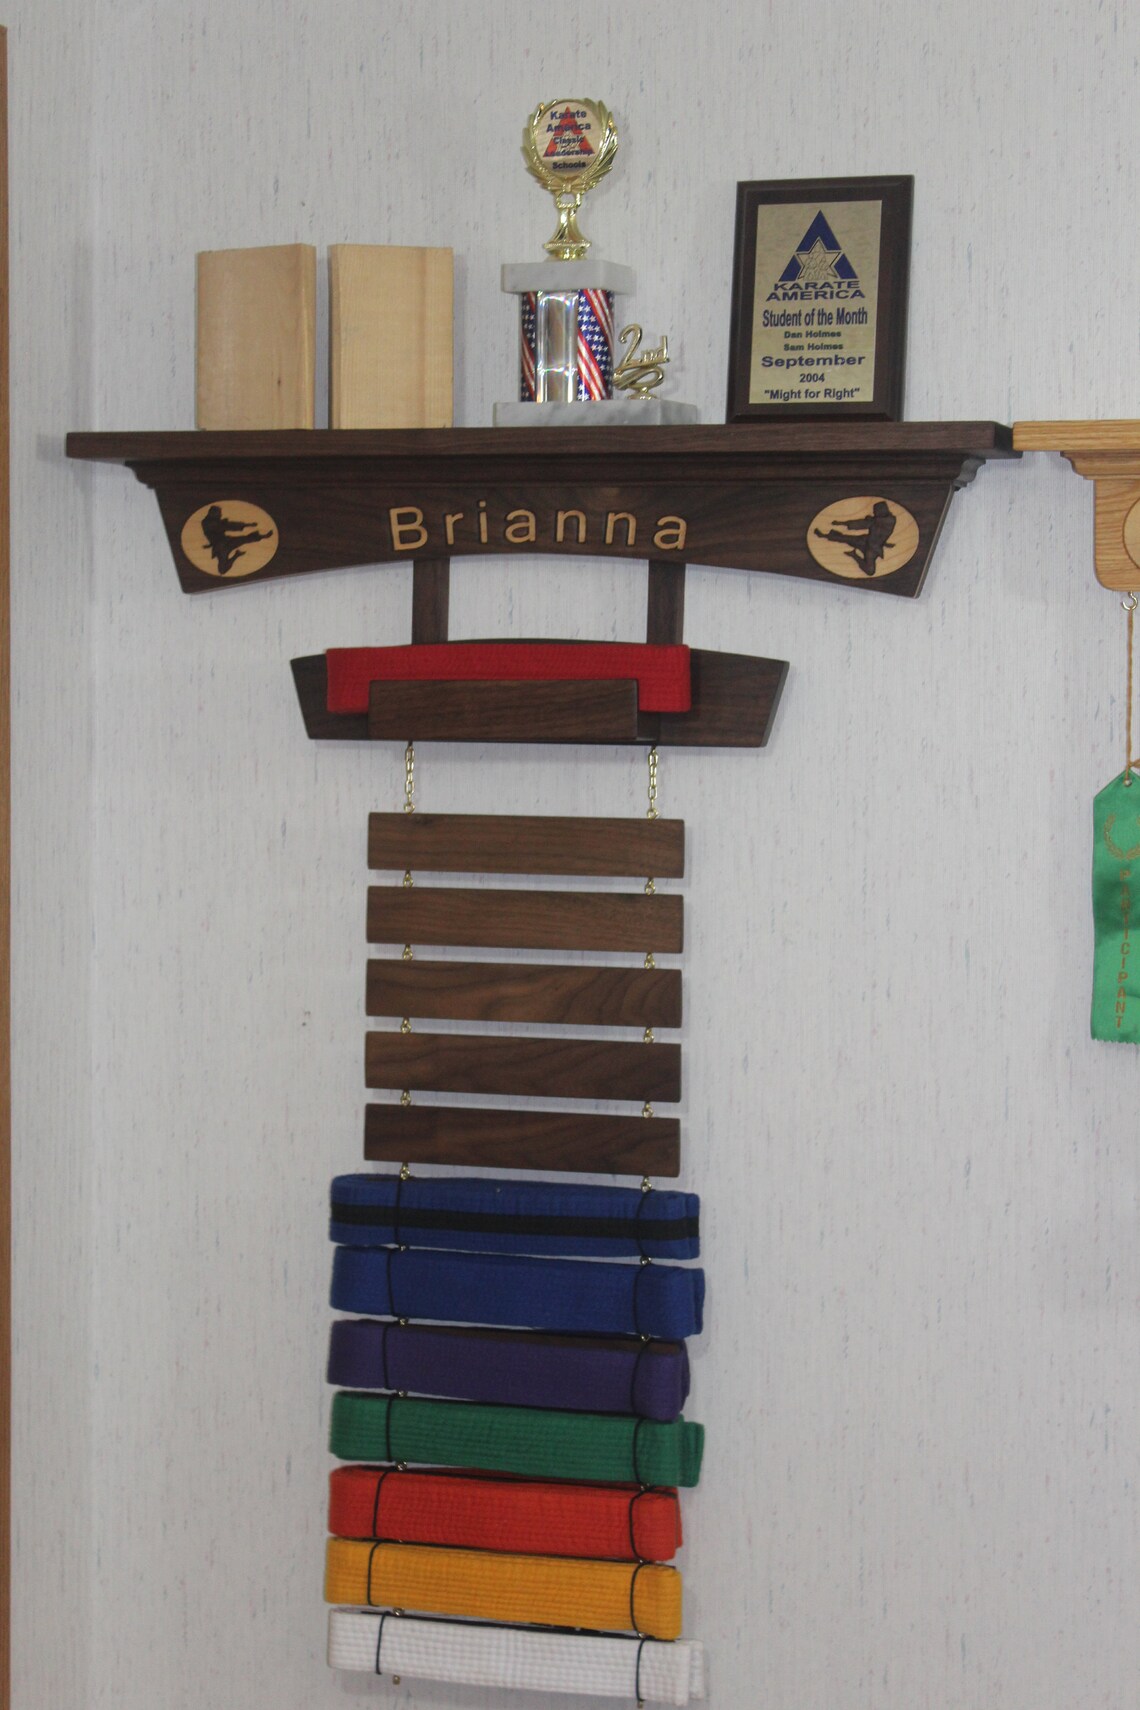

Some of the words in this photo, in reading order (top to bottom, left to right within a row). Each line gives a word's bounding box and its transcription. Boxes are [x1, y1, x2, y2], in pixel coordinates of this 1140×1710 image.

[550, 110, 587, 119] Karate
[546, 122, 591, 132] America
[552, 161, 586, 169] Schools
[774, 281, 860, 291] KARATE
[766, 290, 865, 302] AMERICA
[763, 309, 802, 327] Student
[804, 308, 816, 326] of
[817, 308, 833, 326] the
[836, 307, 868, 325] Month
[784, 331, 802, 339] Dan
[805, 330, 842, 338] Holmes
[761, 355, 866, 369] September
[800, 373, 825, 383] 2004
[764, 389, 801, 402] "Might
[804, 388, 821, 399] for
[824, 387, 860, 400] Right"
[388, 500, 688, 551] Brianna
